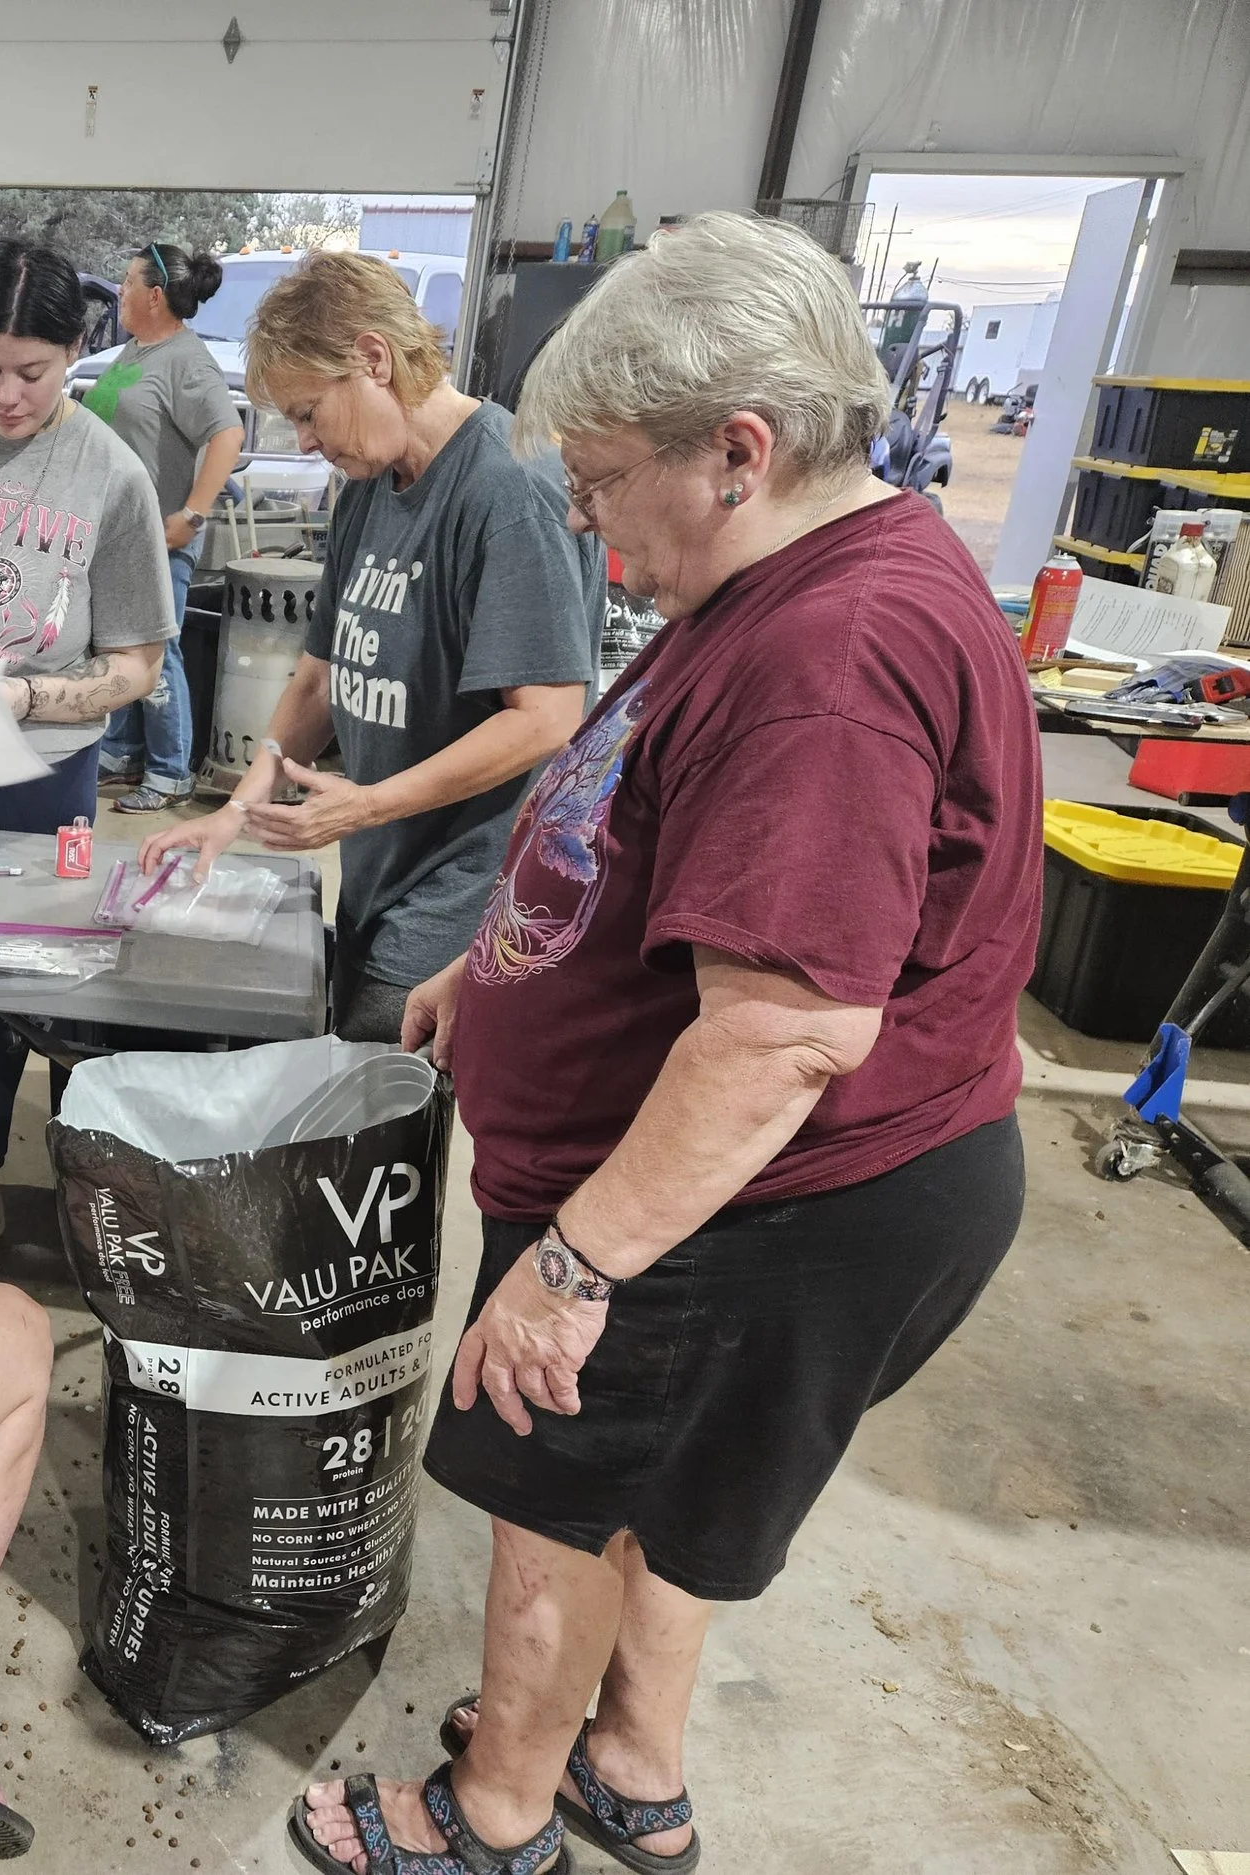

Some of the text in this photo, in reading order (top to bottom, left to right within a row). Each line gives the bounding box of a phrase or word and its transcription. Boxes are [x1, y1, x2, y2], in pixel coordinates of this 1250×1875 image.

[343, 554, 423, 614] ivin'
[334, 608, 380, 667] The
[330, 663, 407, 729] ream
[316, 1163, 421, 1248] VP
[89, 1202, 113, 1283] performance dog food
[97, 1187, 135, 1305] VALU PAK FREE
[125, 1231, 166, 1276] VP
[244, 1263, 338, 1310] VALU
[349, 1244, 418, 1289] PAK
[300, 1284, 425, 1334] performance dog
[158, 1356, 181, 1396] 28
[325, 1342, 414, 1382] FORMULATED
[418, 1332, 432, 1347] FO
[251, 1359, 420, 1407] ACTIVE ADULTS &
[128, 1404, 138, 1424] NO
[127, 1428, 135, 1462] CORN
[143, 1417, 157, 1497] ACTIVE
[322, 1429, 373, 1471] 28
[128, 1472, 135, 1493] NO
[253, 1460, 412, 1520] MADE WITH QUALITY
[332, 1466, 364, 1482] protein
[127, 1496, 135, 1536] WHEAT
[252, 1533, 272, 1543] NO
[277, 1535, 313, 1545] CORN
[326, 1531, 345, 1542] NO
[348, 1514, 380, 1537] WHEAT
[387, 1500, 399, 1515] NO
[251, 1519, 412, 1588] Maintains Healthy Skin
[252, 1555, 298, 1566] Natural
[303, 1553, 347, 1566] Sources
[351, 1546, 361, 1557] of
[122, 1576, 133, 1597] NO
[109, 1600, 126, 1647] GLUTEN
[124, 1588, 154, 1663] UPPIES
